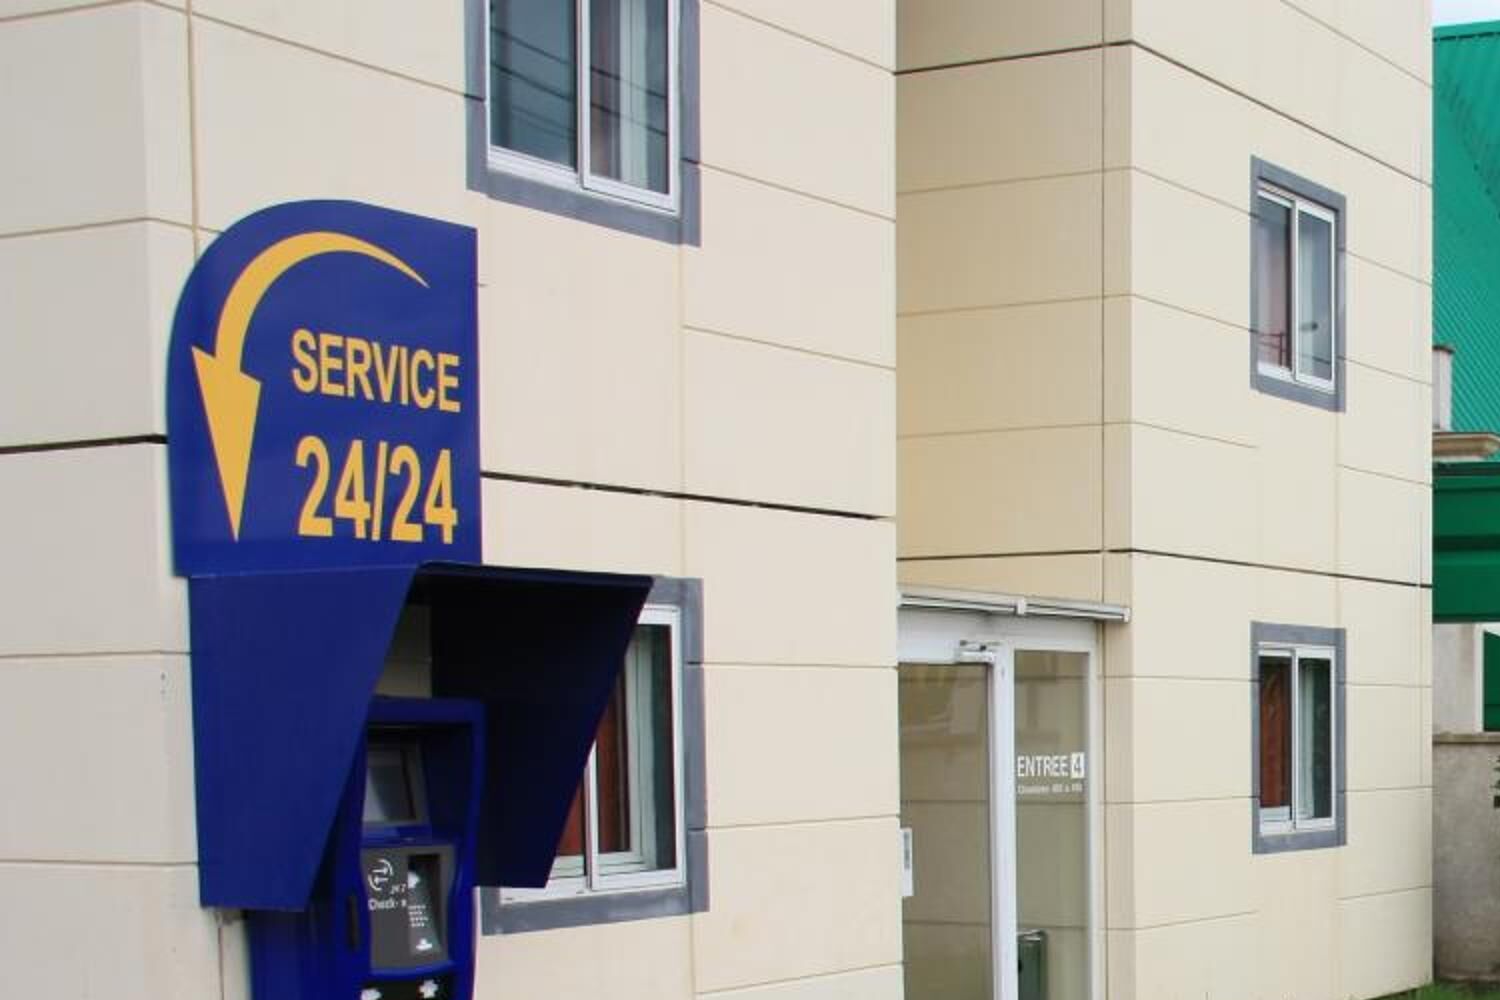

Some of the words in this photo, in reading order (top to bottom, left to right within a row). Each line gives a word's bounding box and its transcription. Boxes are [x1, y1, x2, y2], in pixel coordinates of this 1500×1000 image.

[292, 328, 460, 413] SERVICE
[295, 435, 459, 544] 24/24
[1017, 755, 1069, 777] ENTREE
[1072, 753, 1084, 777] 4
